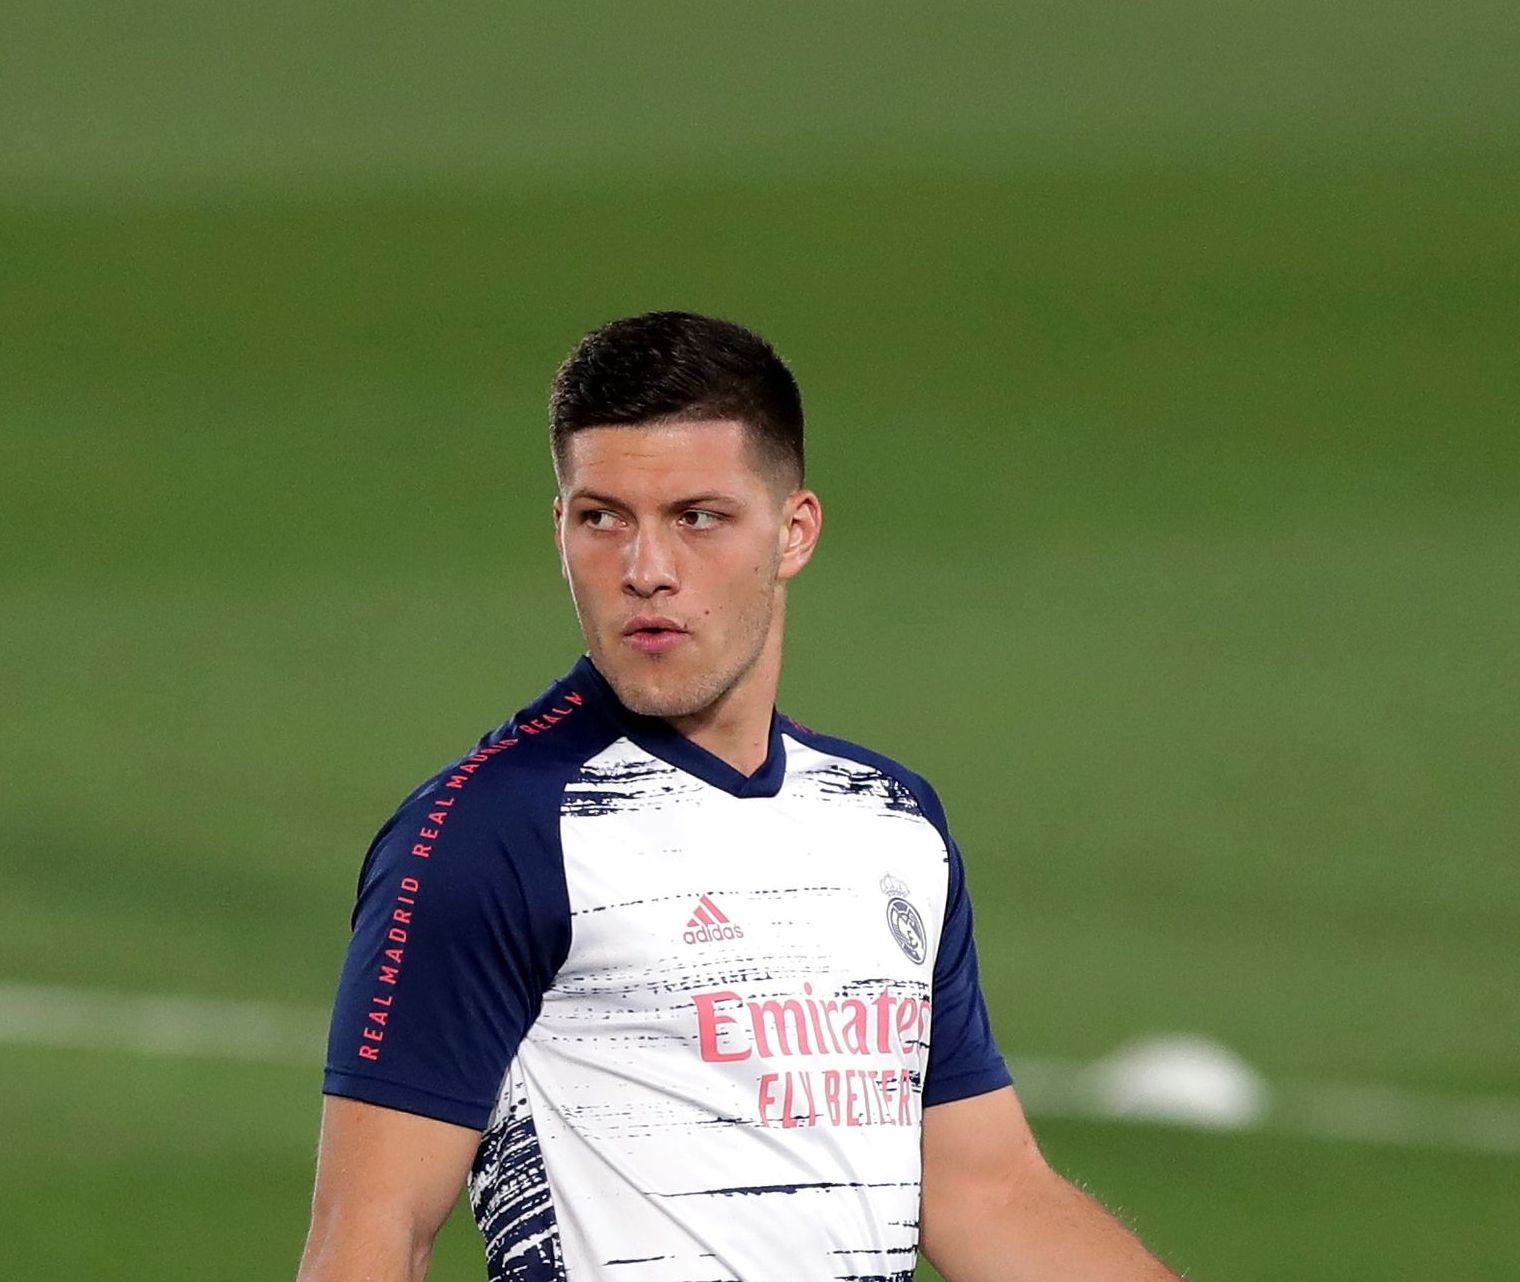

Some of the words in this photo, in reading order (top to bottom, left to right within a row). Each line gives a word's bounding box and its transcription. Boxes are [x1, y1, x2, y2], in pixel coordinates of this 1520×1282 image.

[358, 995, 395, 1061] REAL
[378, 876, 420, 985] MADRID
[411, 797, 456, 859] REAL
[518, 707, 573, 735] REAL
[683, 923, 744, 945] adidas
[758, 1070, 816, 1128] FLY
